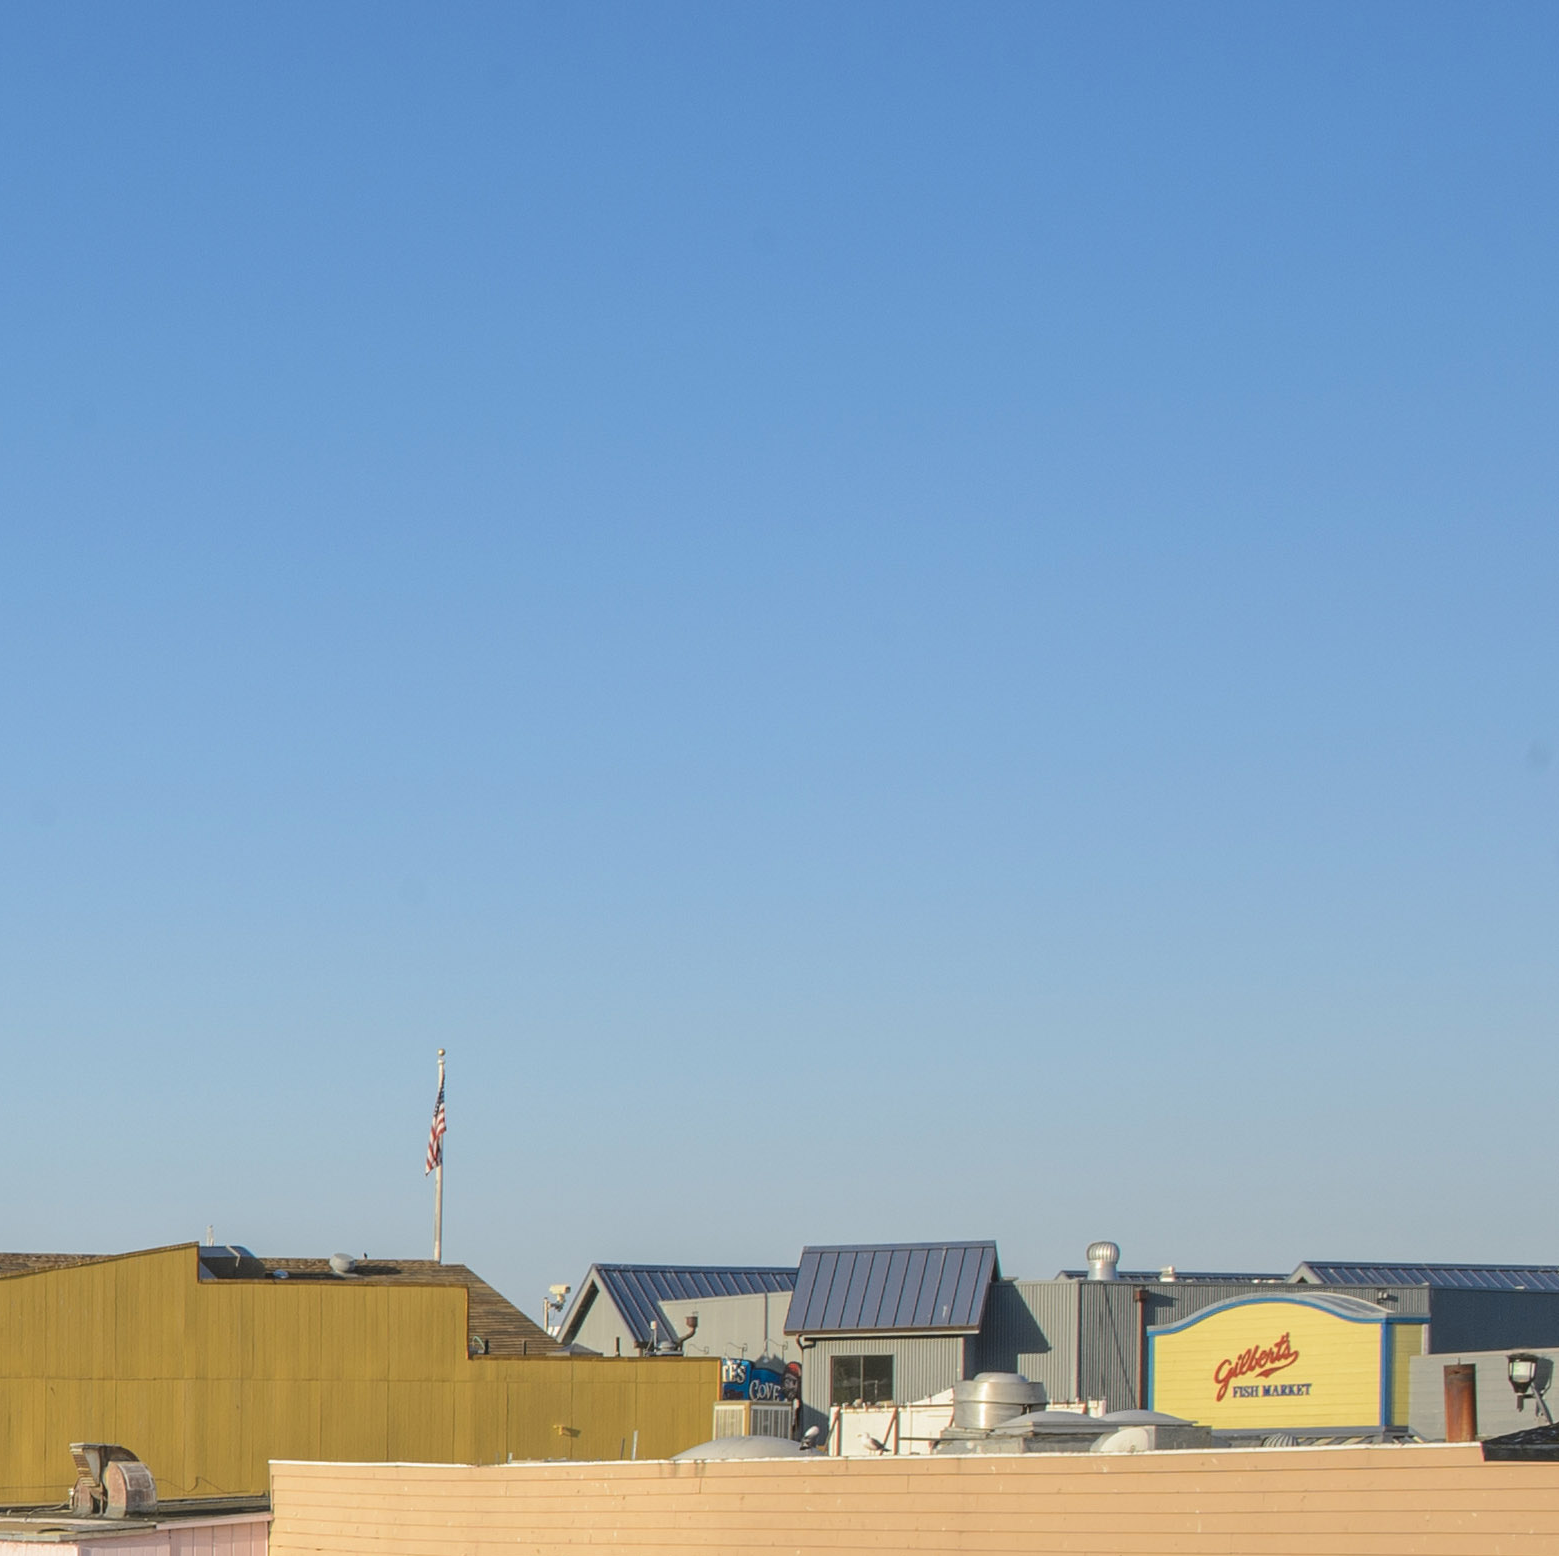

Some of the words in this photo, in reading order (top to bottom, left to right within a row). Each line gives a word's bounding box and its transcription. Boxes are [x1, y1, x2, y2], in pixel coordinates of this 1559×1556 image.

[1214, 1332, 1299, 1402] Gilbert's
[1232, 1385, 1260, 1398] FISH
[1262, 1383, 1312, 1397] MARKET
